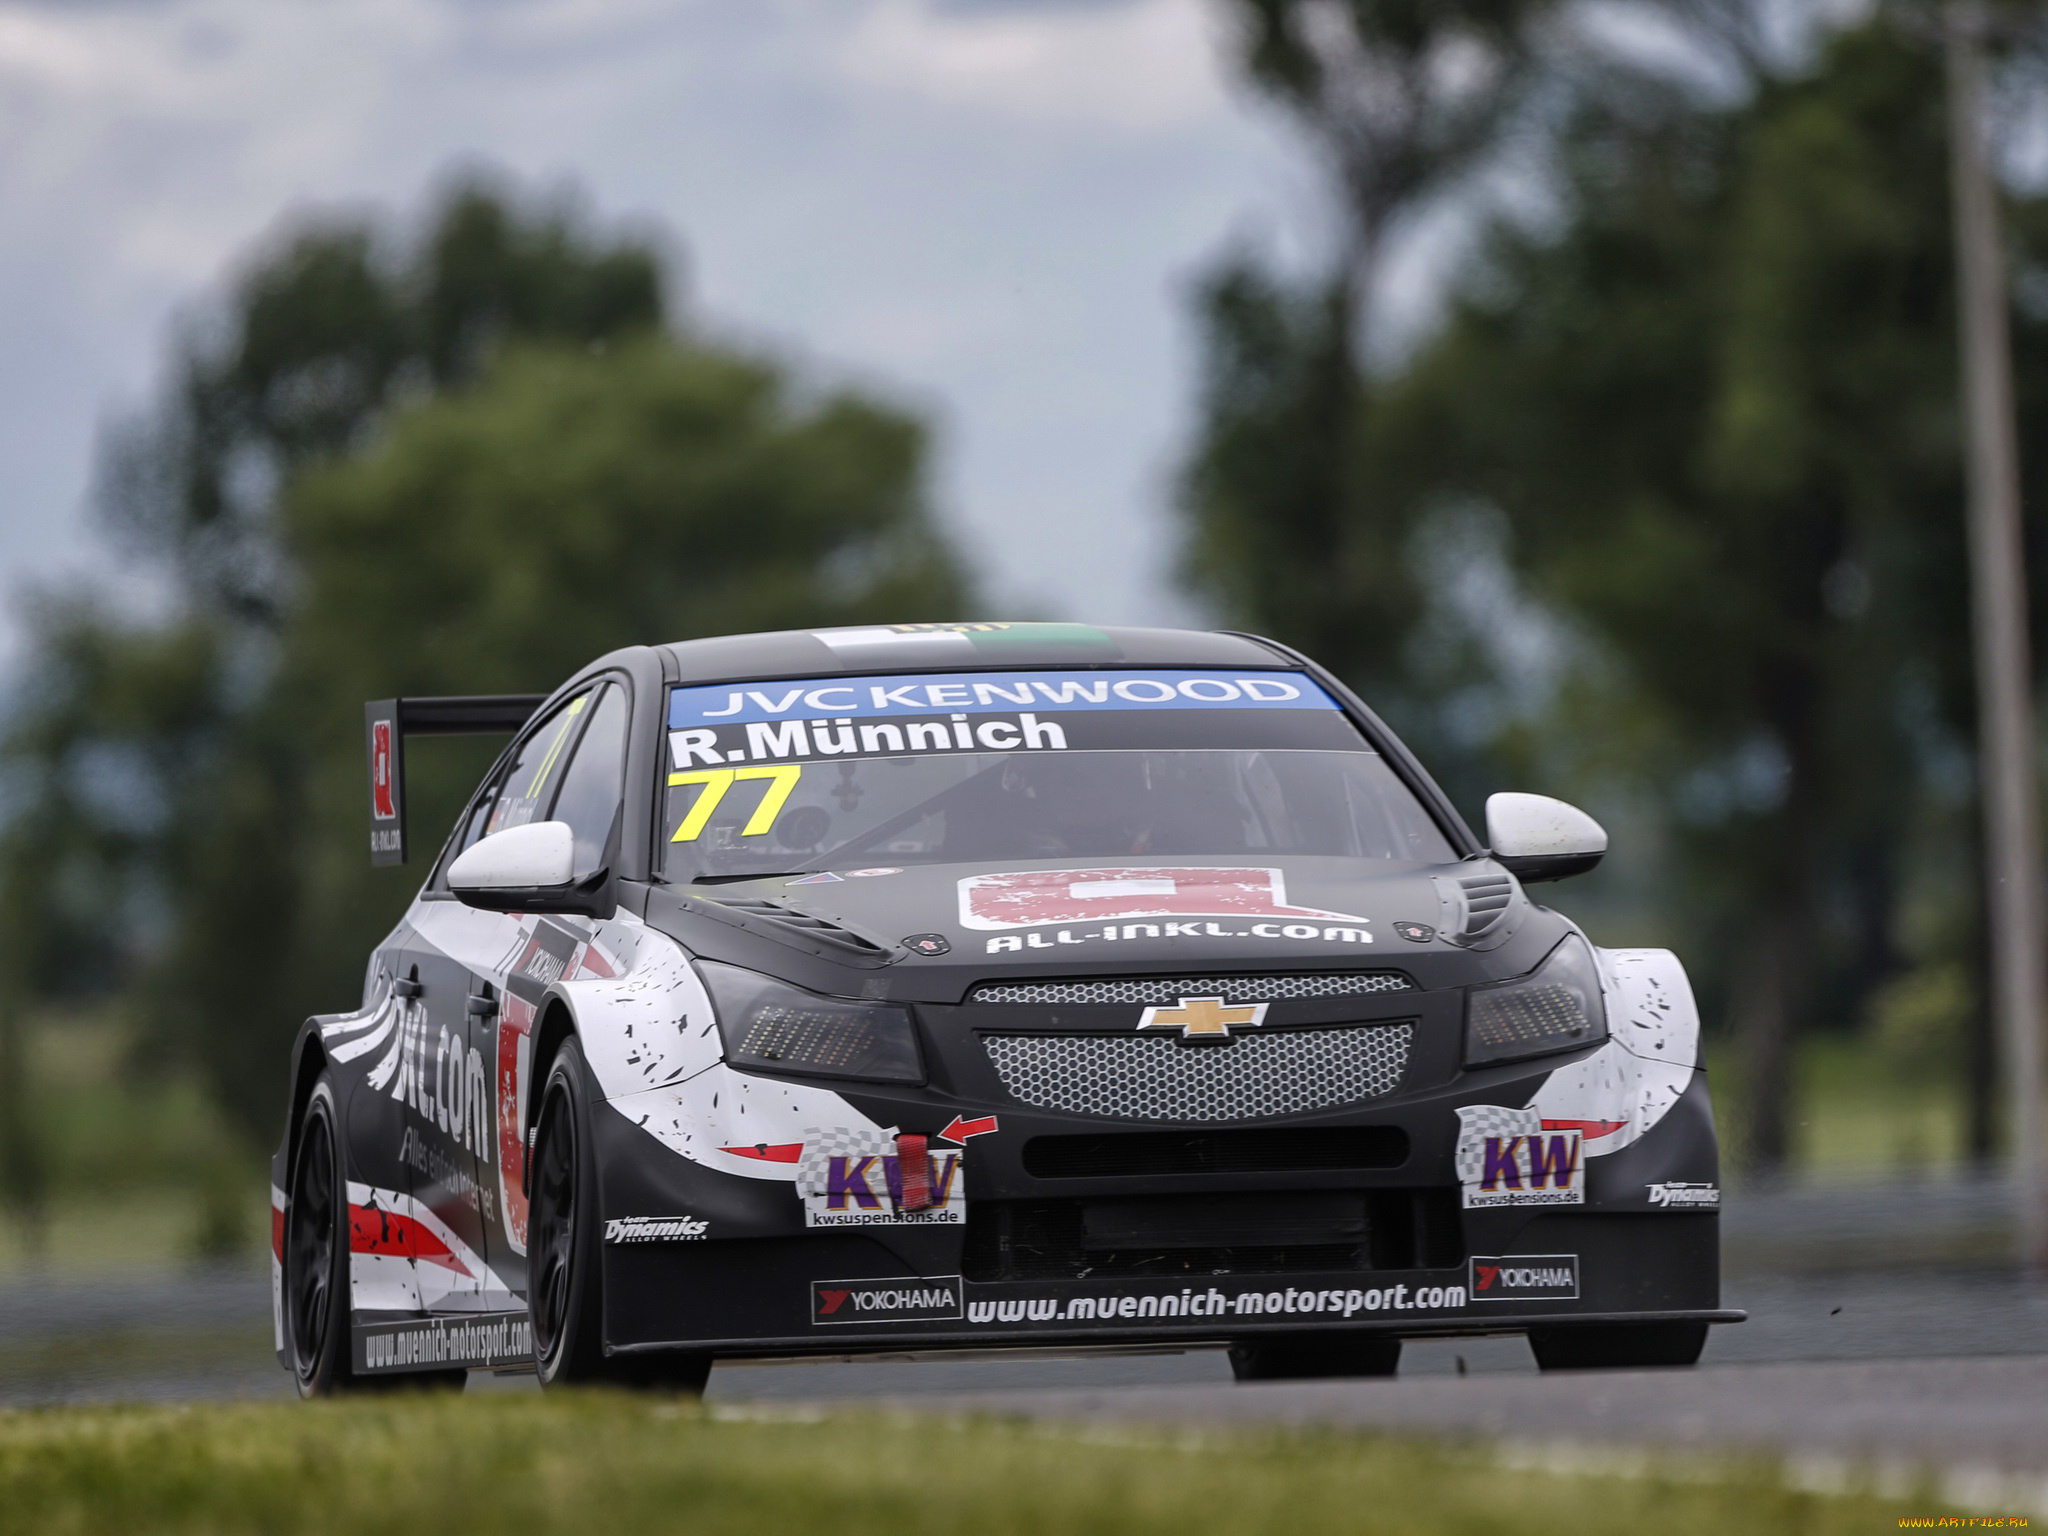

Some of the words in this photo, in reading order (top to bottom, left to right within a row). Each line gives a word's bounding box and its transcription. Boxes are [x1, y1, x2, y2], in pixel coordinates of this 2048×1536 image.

[703, 689, 860, 717] JVC
[871, 679, 1302, 710] KENWOOD
[670, 713, 1069, 768] R.Münnich
[669, 765, 802, 843] 77
[1478, 1134, 1580, 1192] KW
[605, 1216, 710, 1244] Dynamics
[1499, 1268, 1574, 1288] YOKOHAMA
[851, 1288, 955, 1310] YOKOHAMA
[967, 1284, 1466, 1323] www.muennich-motorsport.com
[366, 1317, 532, 1368] www.muennich-motorsport.com
